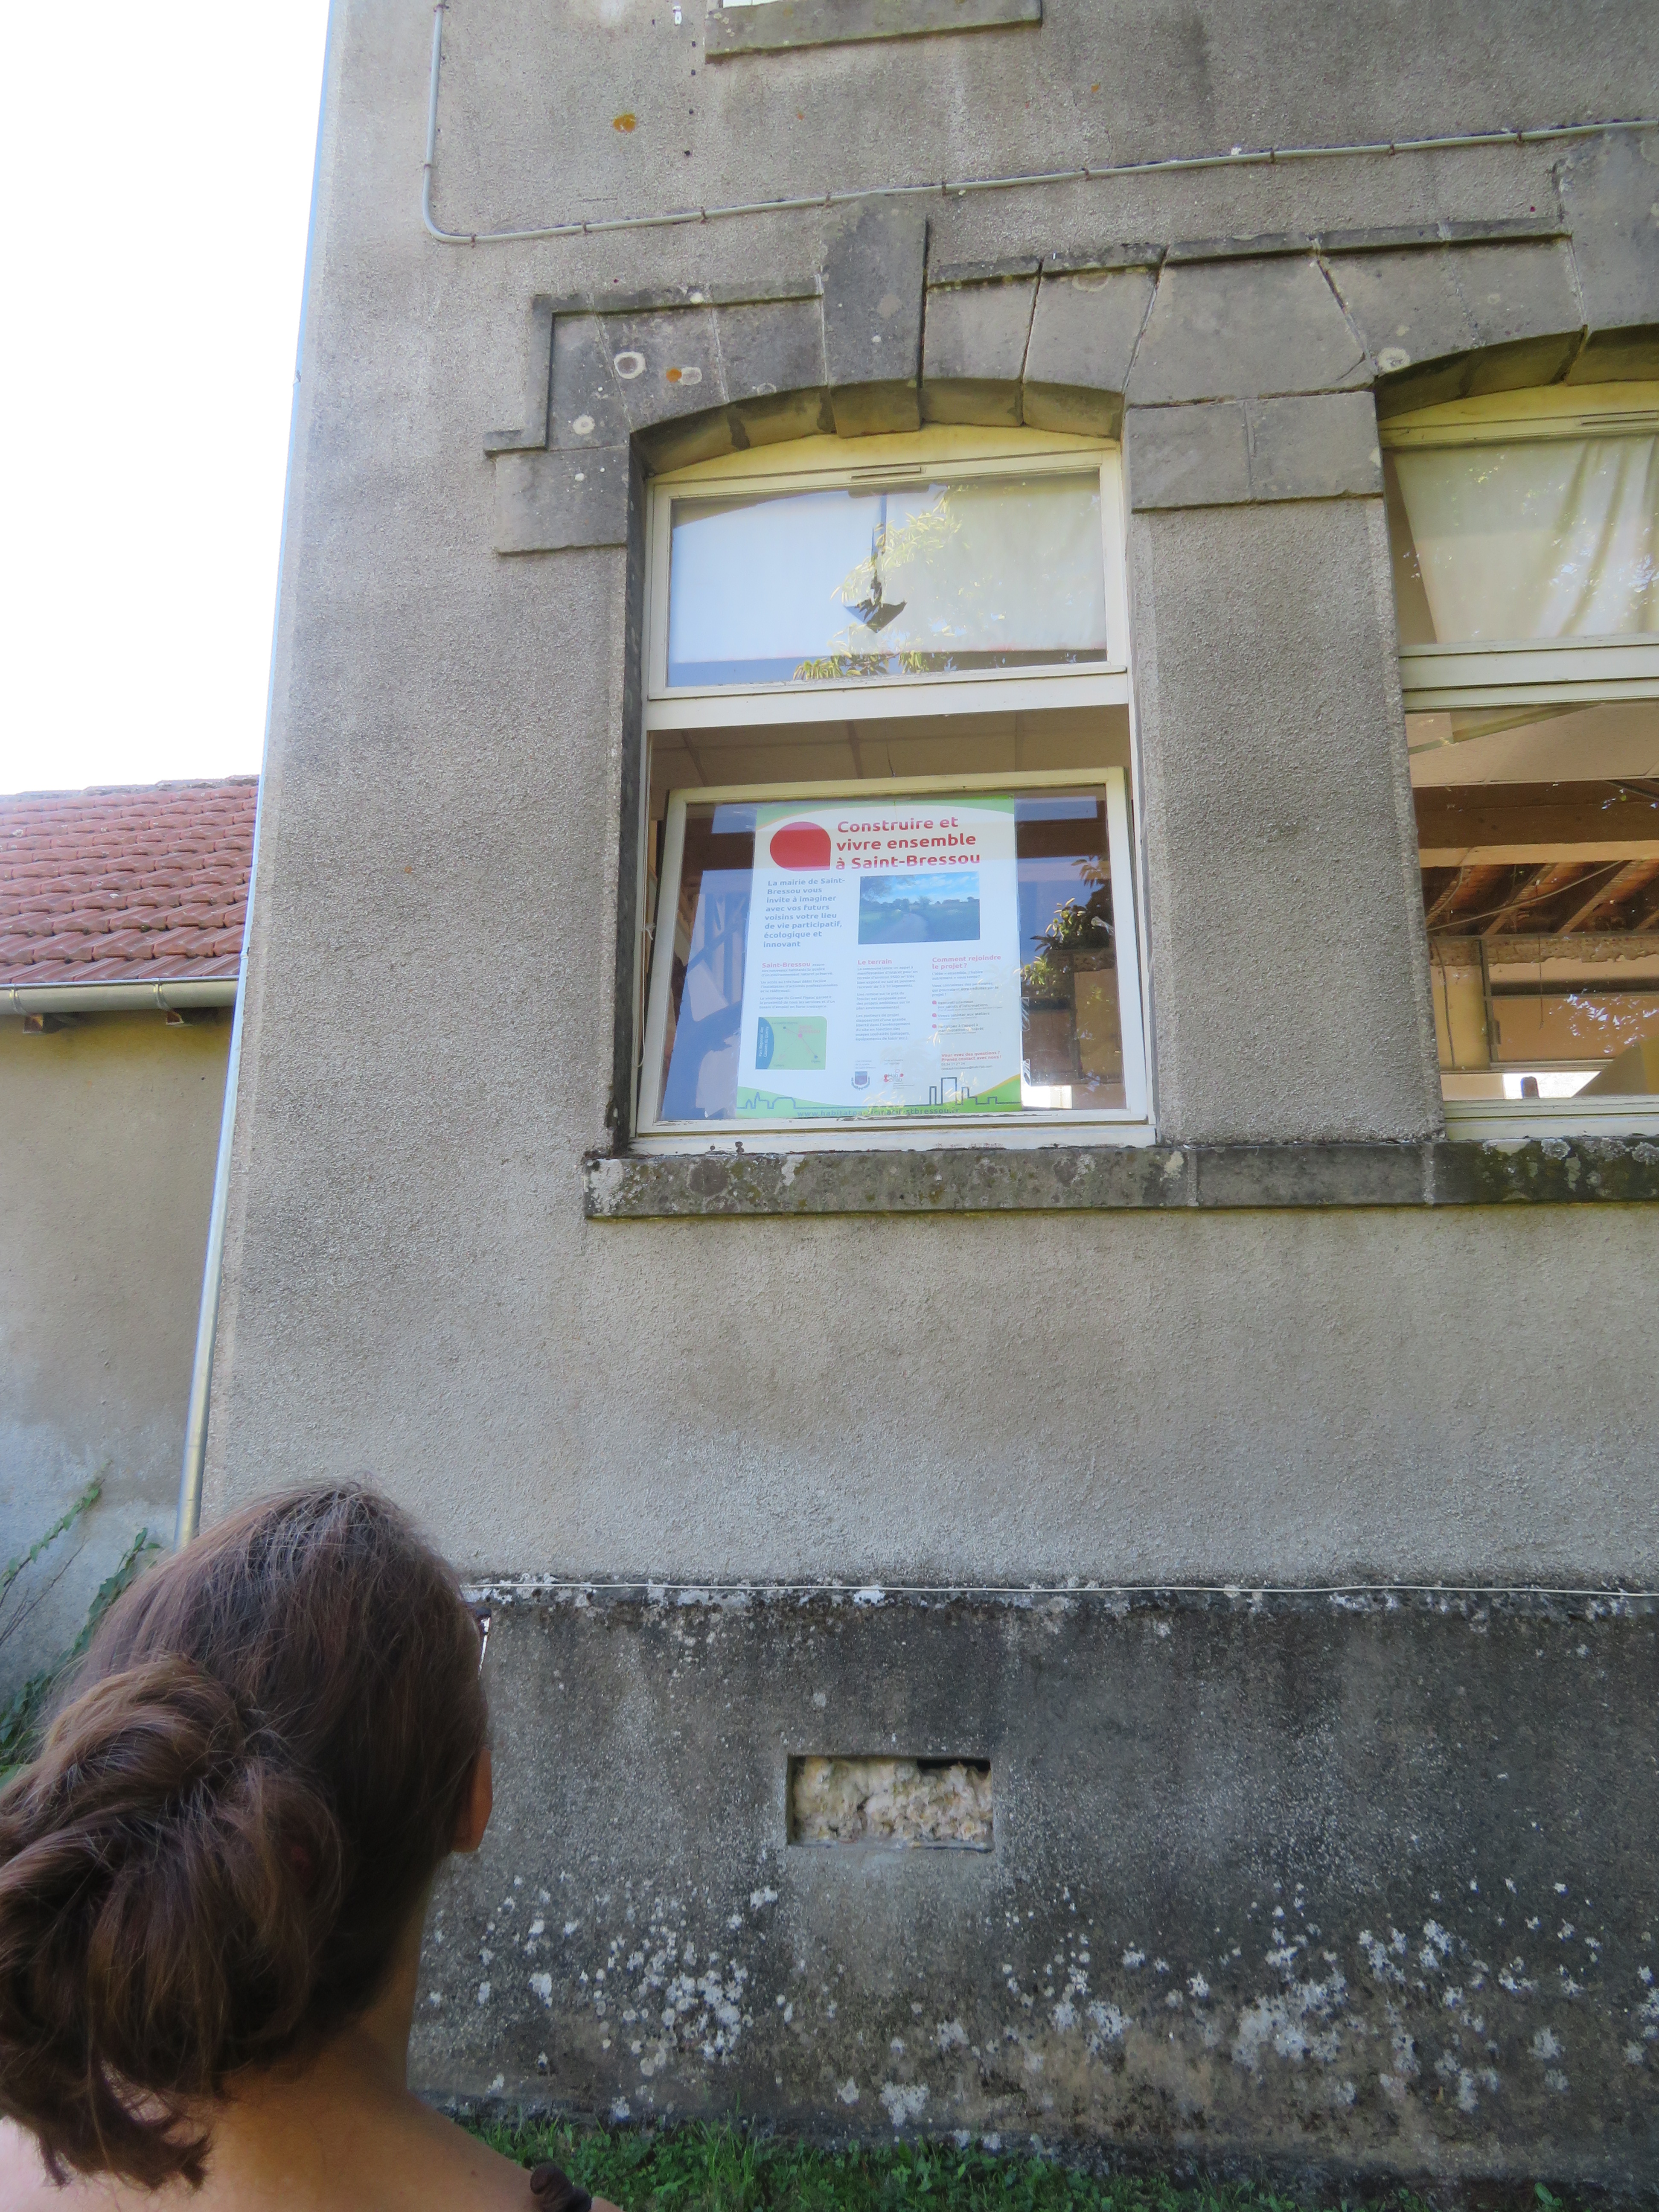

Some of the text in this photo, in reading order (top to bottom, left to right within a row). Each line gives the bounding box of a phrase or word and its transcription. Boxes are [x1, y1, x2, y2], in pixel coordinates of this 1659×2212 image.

[838, 817, 958, 833] Construire et
[837, 833, 976, 851] vivre ensemble
[835, 854, 981, 870] à Saint-Bressou
[799, 895, 836, 903] imaginer
[792, 920, 842, 929] participatif,
[764, 931, 810, 939] écologique
